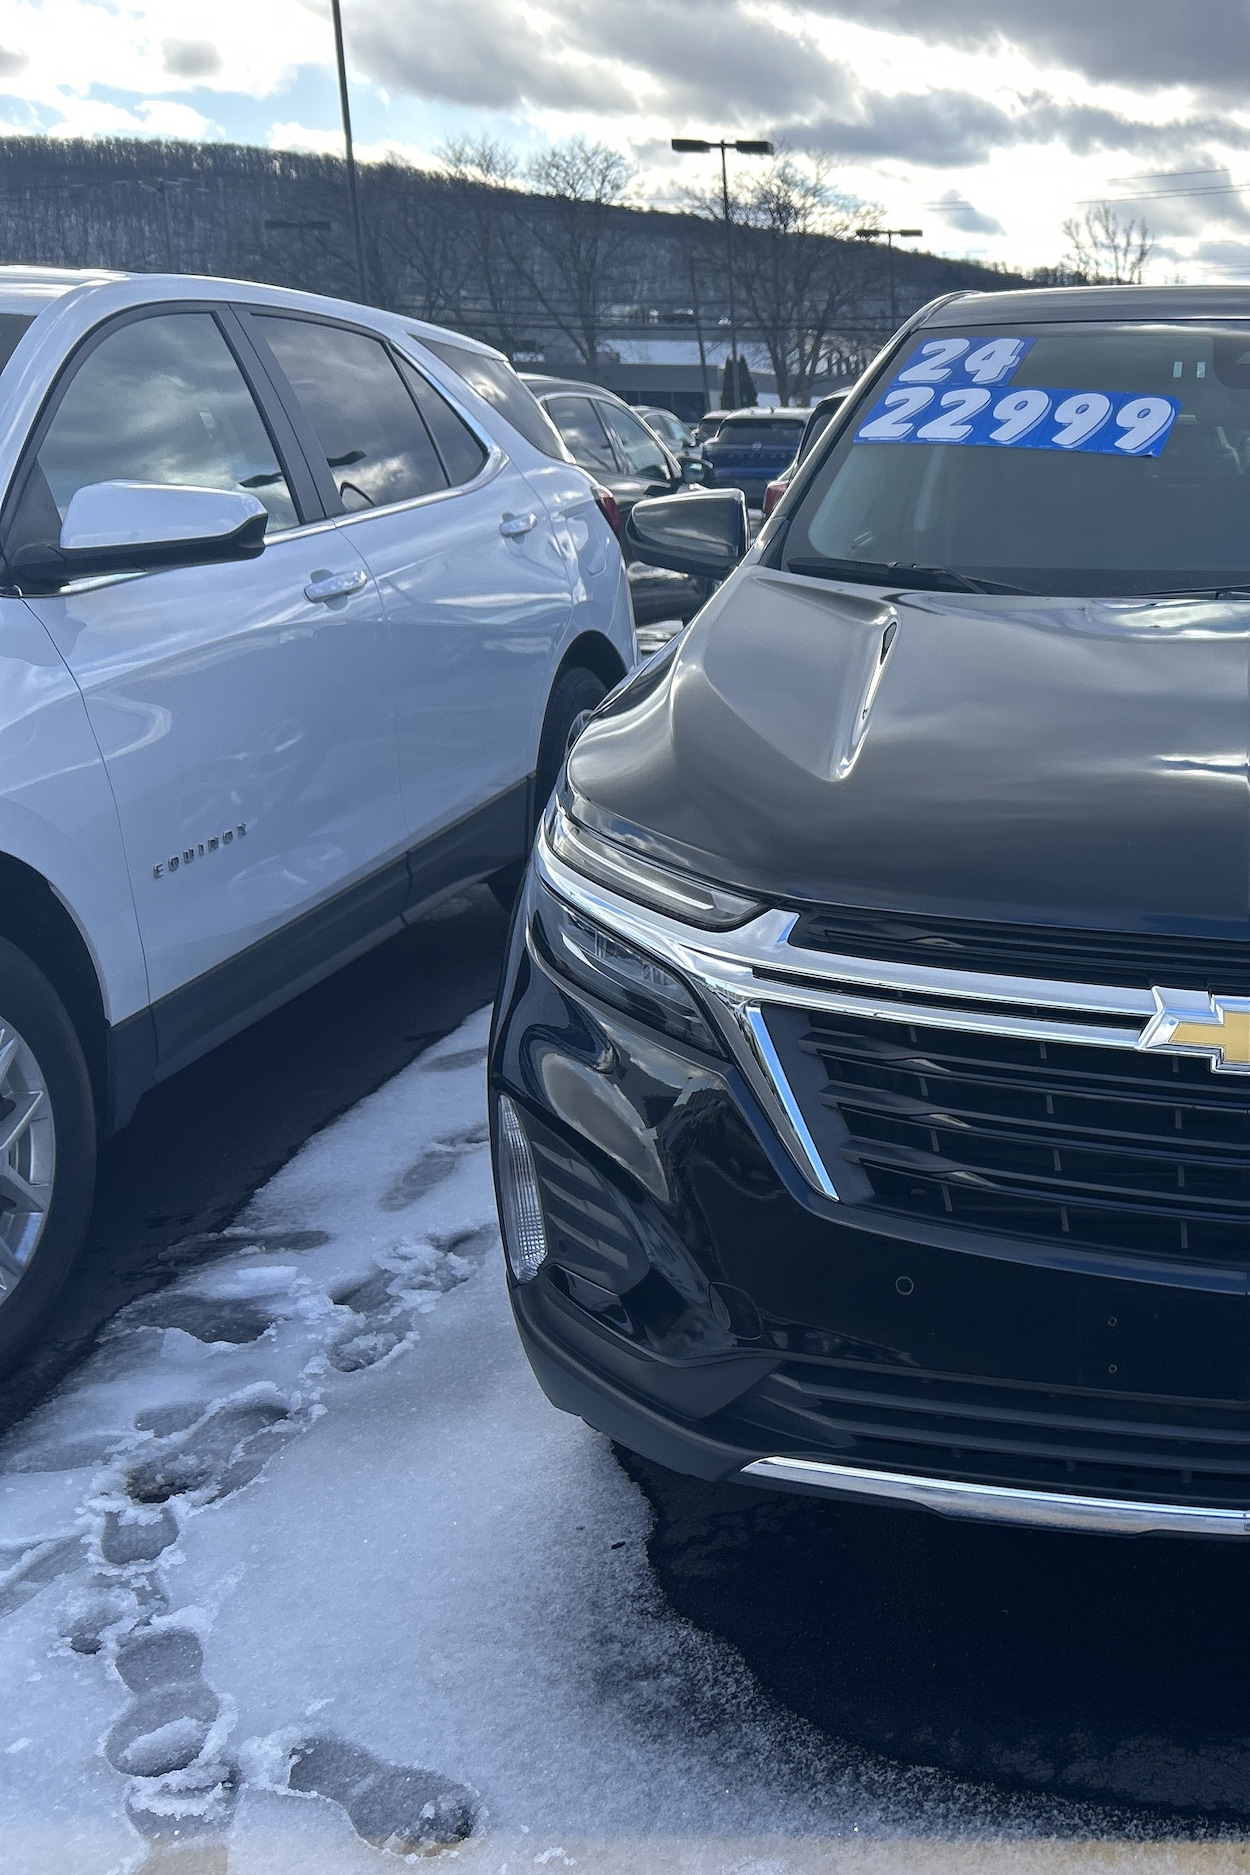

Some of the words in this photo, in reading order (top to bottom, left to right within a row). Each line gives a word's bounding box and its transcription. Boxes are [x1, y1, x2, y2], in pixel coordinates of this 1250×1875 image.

[898, 338, 1021, 385] 24
[858, 386, 1175, 453] 22999
[152, 821, 248, 880] EQUINOX
